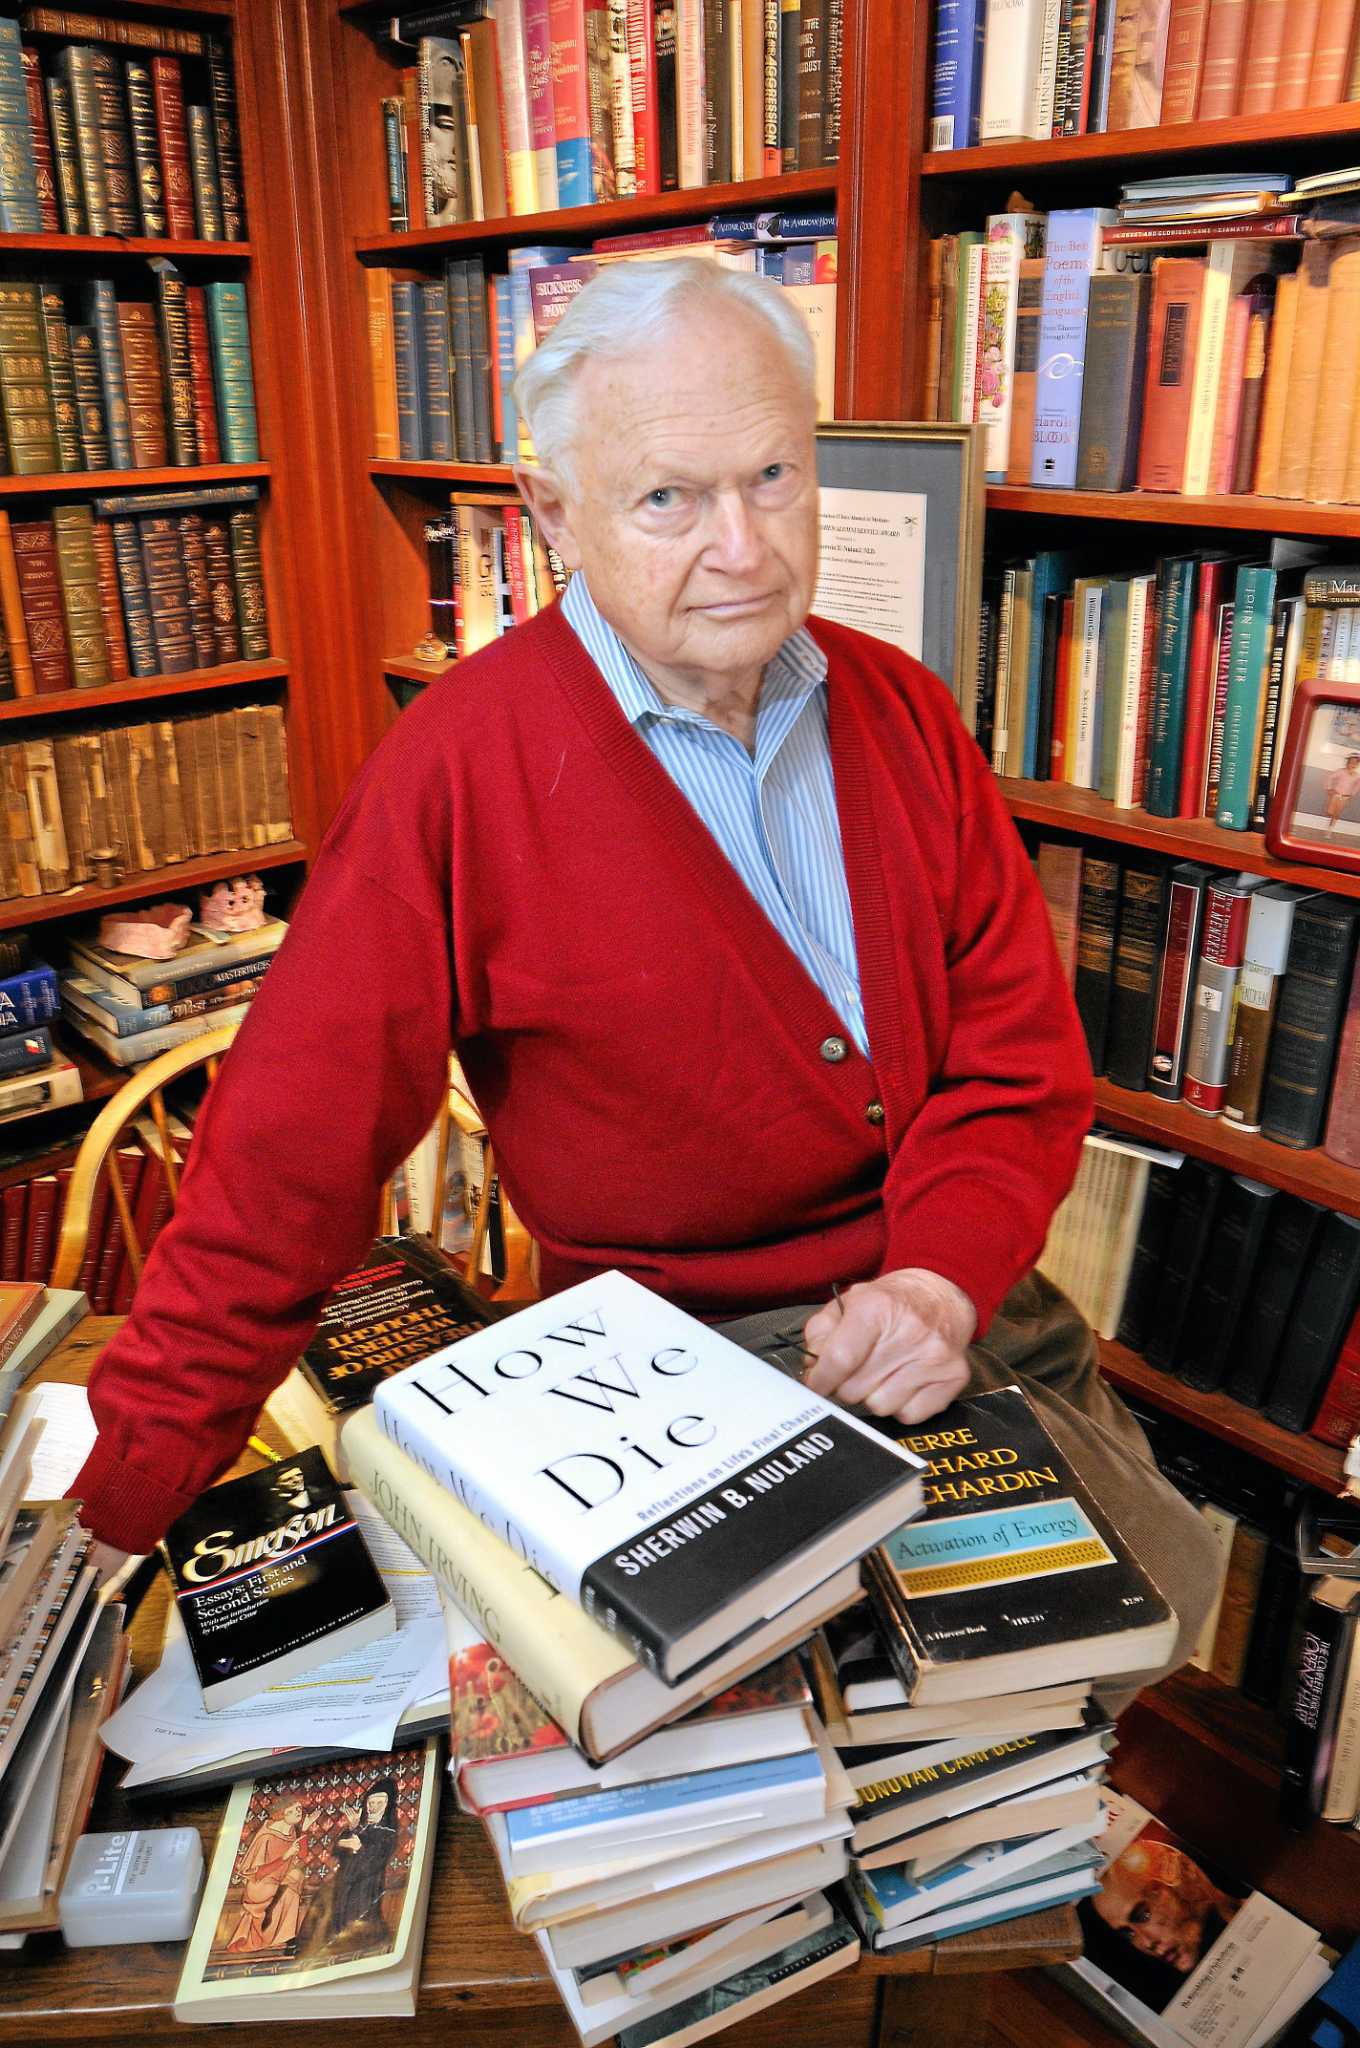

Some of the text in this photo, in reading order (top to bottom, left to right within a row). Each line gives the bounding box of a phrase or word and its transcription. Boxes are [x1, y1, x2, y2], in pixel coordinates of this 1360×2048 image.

[764, 55, 777, 145] AGGRESSION
[1053, 32, 1070, 121] HAROLD BLOOM
[1239, 587, 1256, 625] JOHN
[1234, 632, 1250, 682] FULLER
[1207, 912, 1223, 963] MENCKEN
[327, 1304, 450, 1351] THOUGHT
[338, 1315, 456, 1360] WESTERN
[326, 1358, 364, 1381] OF
[410, 1307, 606, 1416] How
[542, 1348, 699, 1413] We
[536, 1415, 717, 1515] Die
[638, 1403, 825, 1522] Reflections on Life's Final Chapter
[897, 1428, 977, 1452] IERRE
[921, 1448, 1019, 1478] HARD
[615, 1432, 834, 1575] SHERWIN B. NULAND
[183, 1504, 344, 1583] Emerson
[370, 1469, 501, 1642] JOHN IRVING
[899, 1516, 1079, 1558] Activation of Energy
[194, 1554, 307, 1608] Essays: First and
[197, 1575, 294, 1620] Second Series
[200, 1618, 218, 1628] With
[230, 1599, 270, 1618] introduction
[202, 1627, 211, 1636] by
[234, 1656, 260, 1670] VINTAGE
[262, 1647, 282, 1659] BOOKS
[288, 1638, 300, 1647] THE
[301, 1625, 327, 1641] LIBRARY
[338, 1607, 364, 1624] AMERICA
[966, 1625, 987, 1634] Book
[1313, 1655, 1327, 1694] COMPLETE
[86, 1833, 126, 1892] i-Lite
